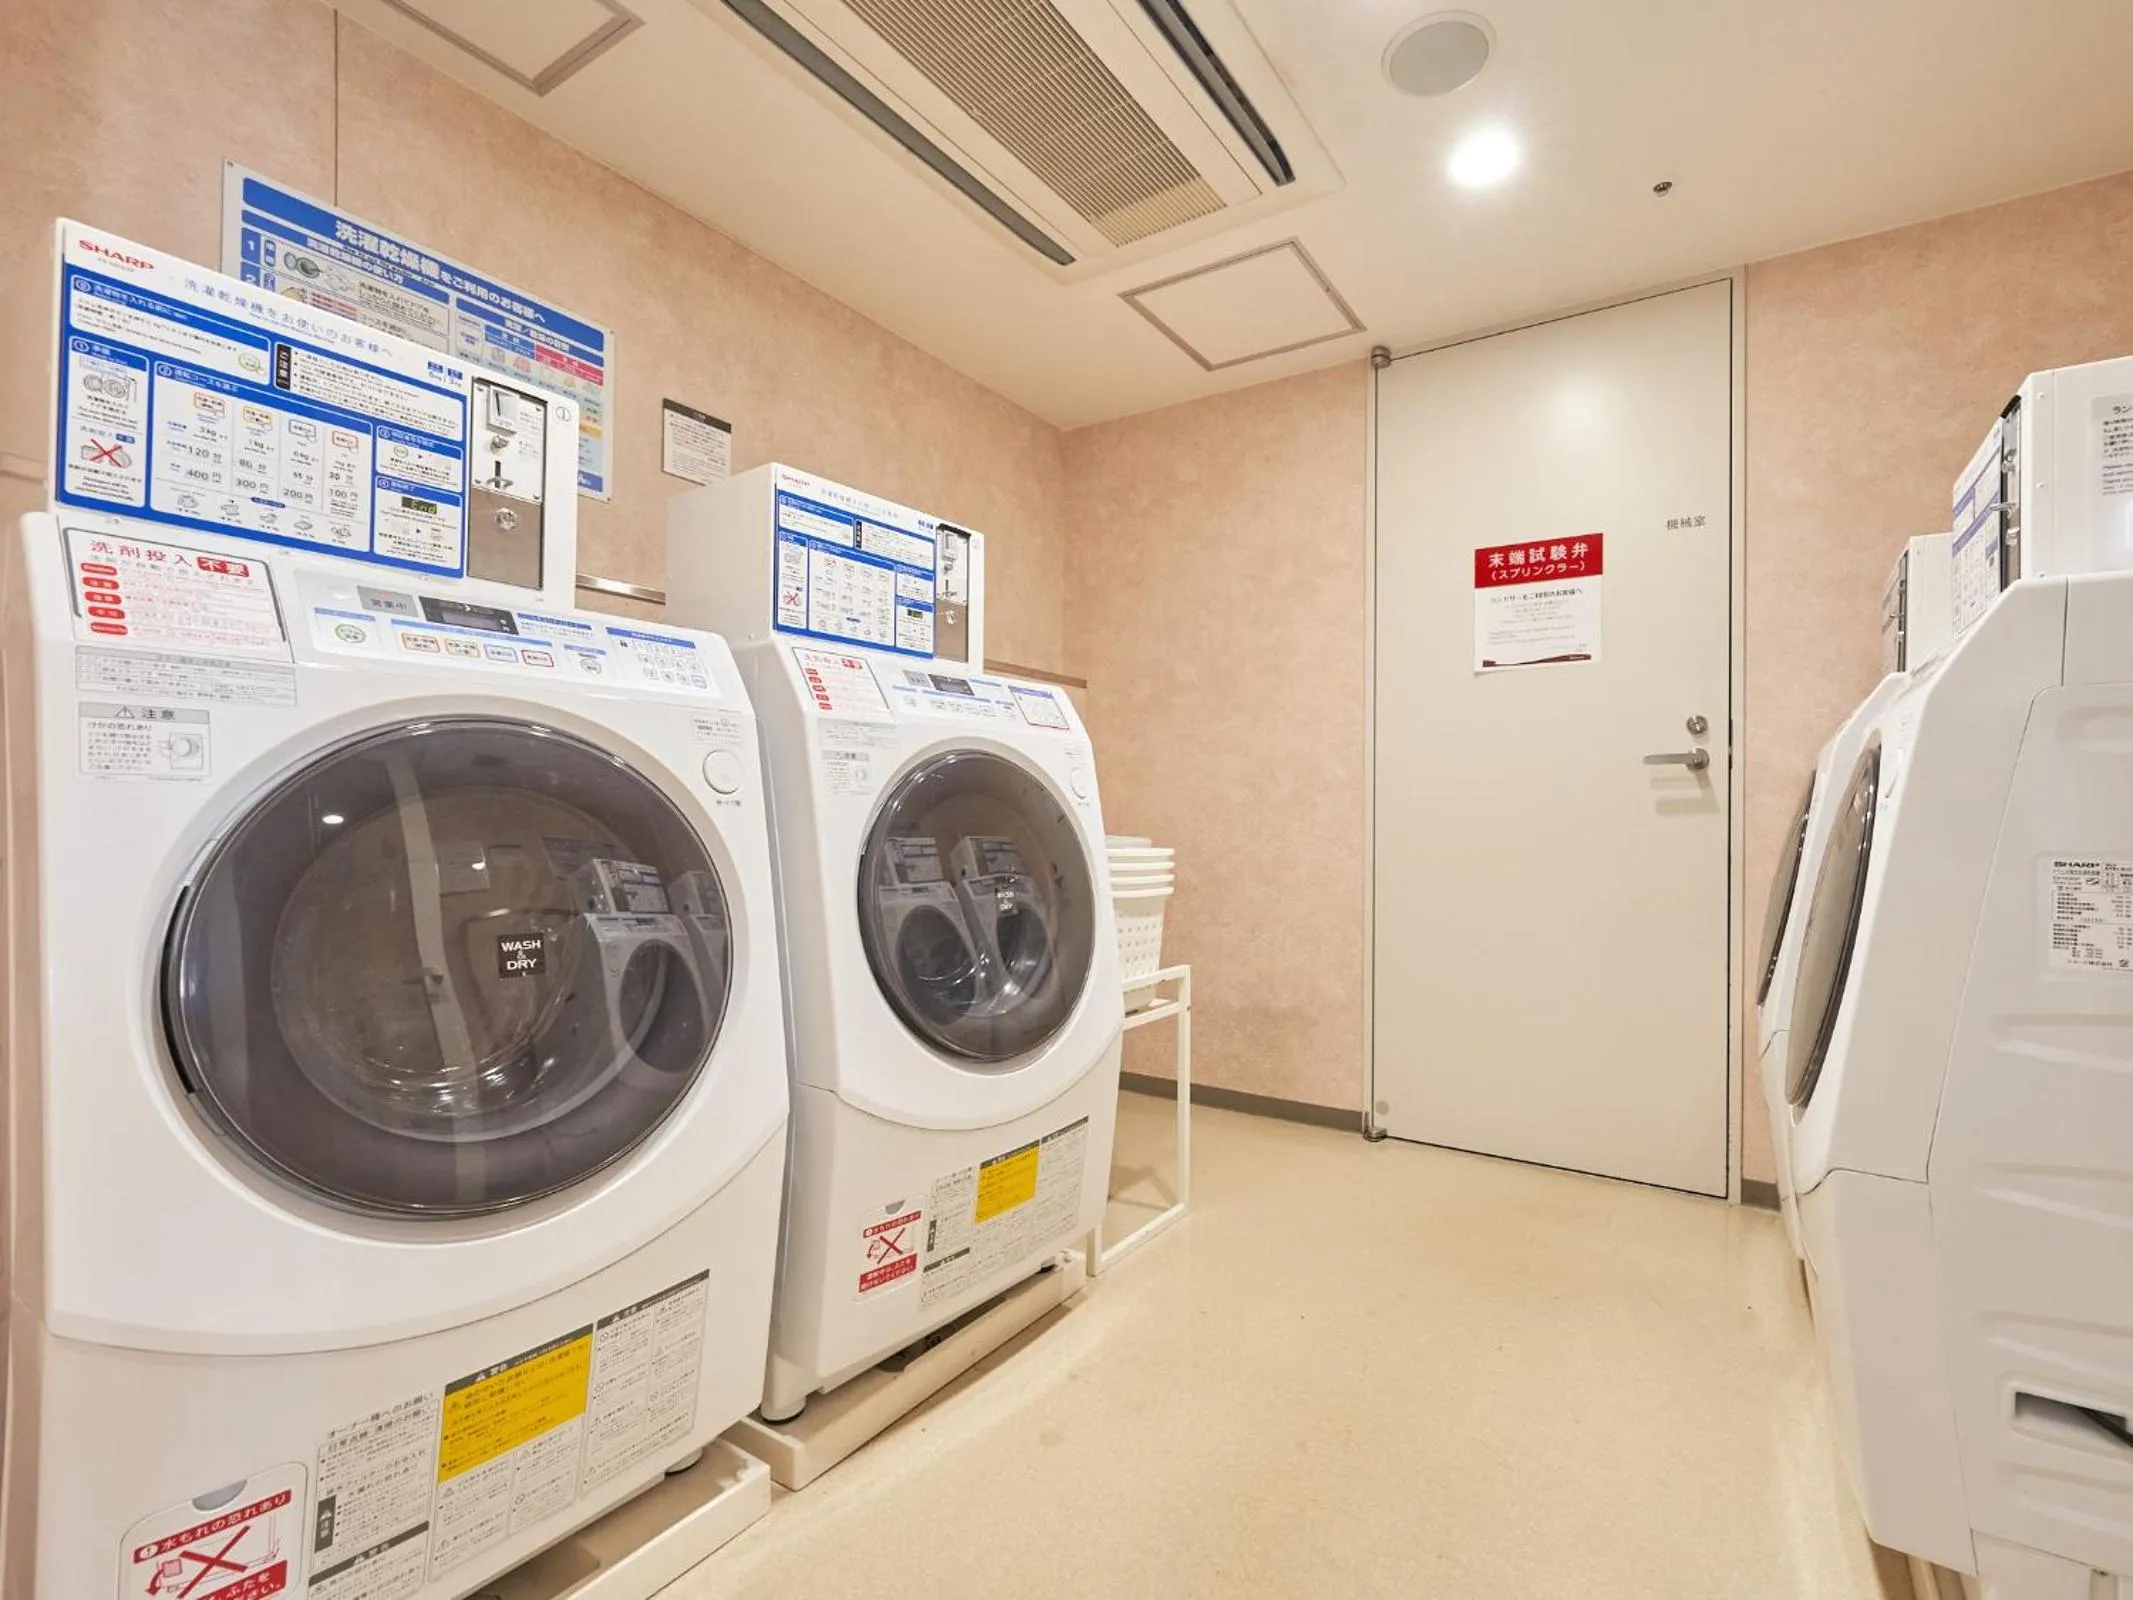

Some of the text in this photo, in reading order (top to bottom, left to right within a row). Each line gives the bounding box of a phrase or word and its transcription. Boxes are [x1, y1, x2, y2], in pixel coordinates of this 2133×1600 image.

[79, 240, 154, 270] SHARP
[188, 445, 210, 458] 120
[187, 468, 209, 481] 400
[283, 488, 303, 499] 200
[329, 488, 347, 499] 100
[91, 540, 192, 568] 洗剤投入
[1488, 542, 1588, 568] 末端試験弁
[141, 708, 176, 721] 注意
[501, 939, 542, 952] WASH
[516, 950, 527, 960] &
[506, 958, 538, 970] DRY
[162, 1494, 286, 1550] 水もれの恐れあり
